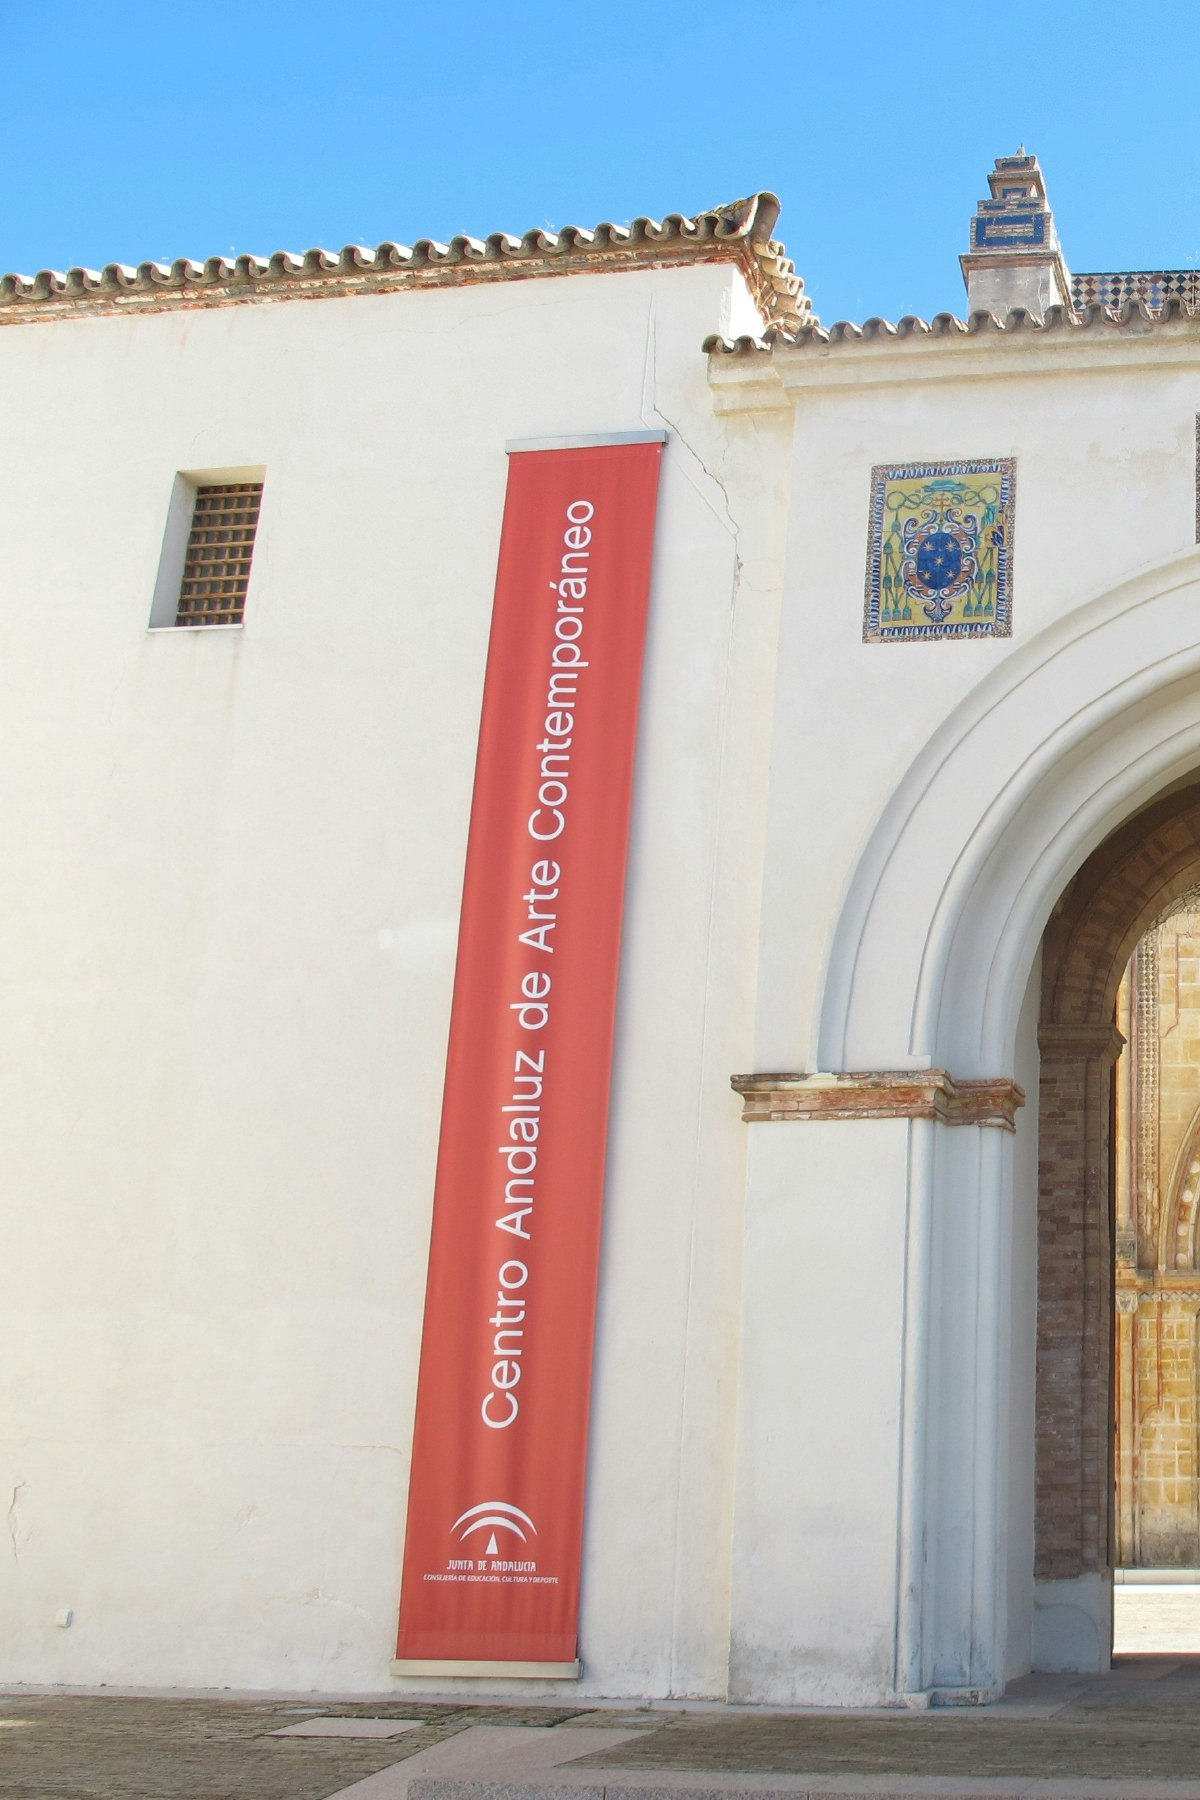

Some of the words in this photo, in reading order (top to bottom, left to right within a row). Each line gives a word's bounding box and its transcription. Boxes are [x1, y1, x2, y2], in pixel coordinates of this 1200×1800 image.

[528, 501, 594, 840] Contemporáneo
[518, 860, 560, 953] Arte
[510, 972, 551, 1030] de
[495, 1050, 544, 1239] Andaluz
[481, 1260, 528, 1428] Centro
[447, 1560, 473, 1570] JUNTA
[478, 1560, 487, 1570] DE
